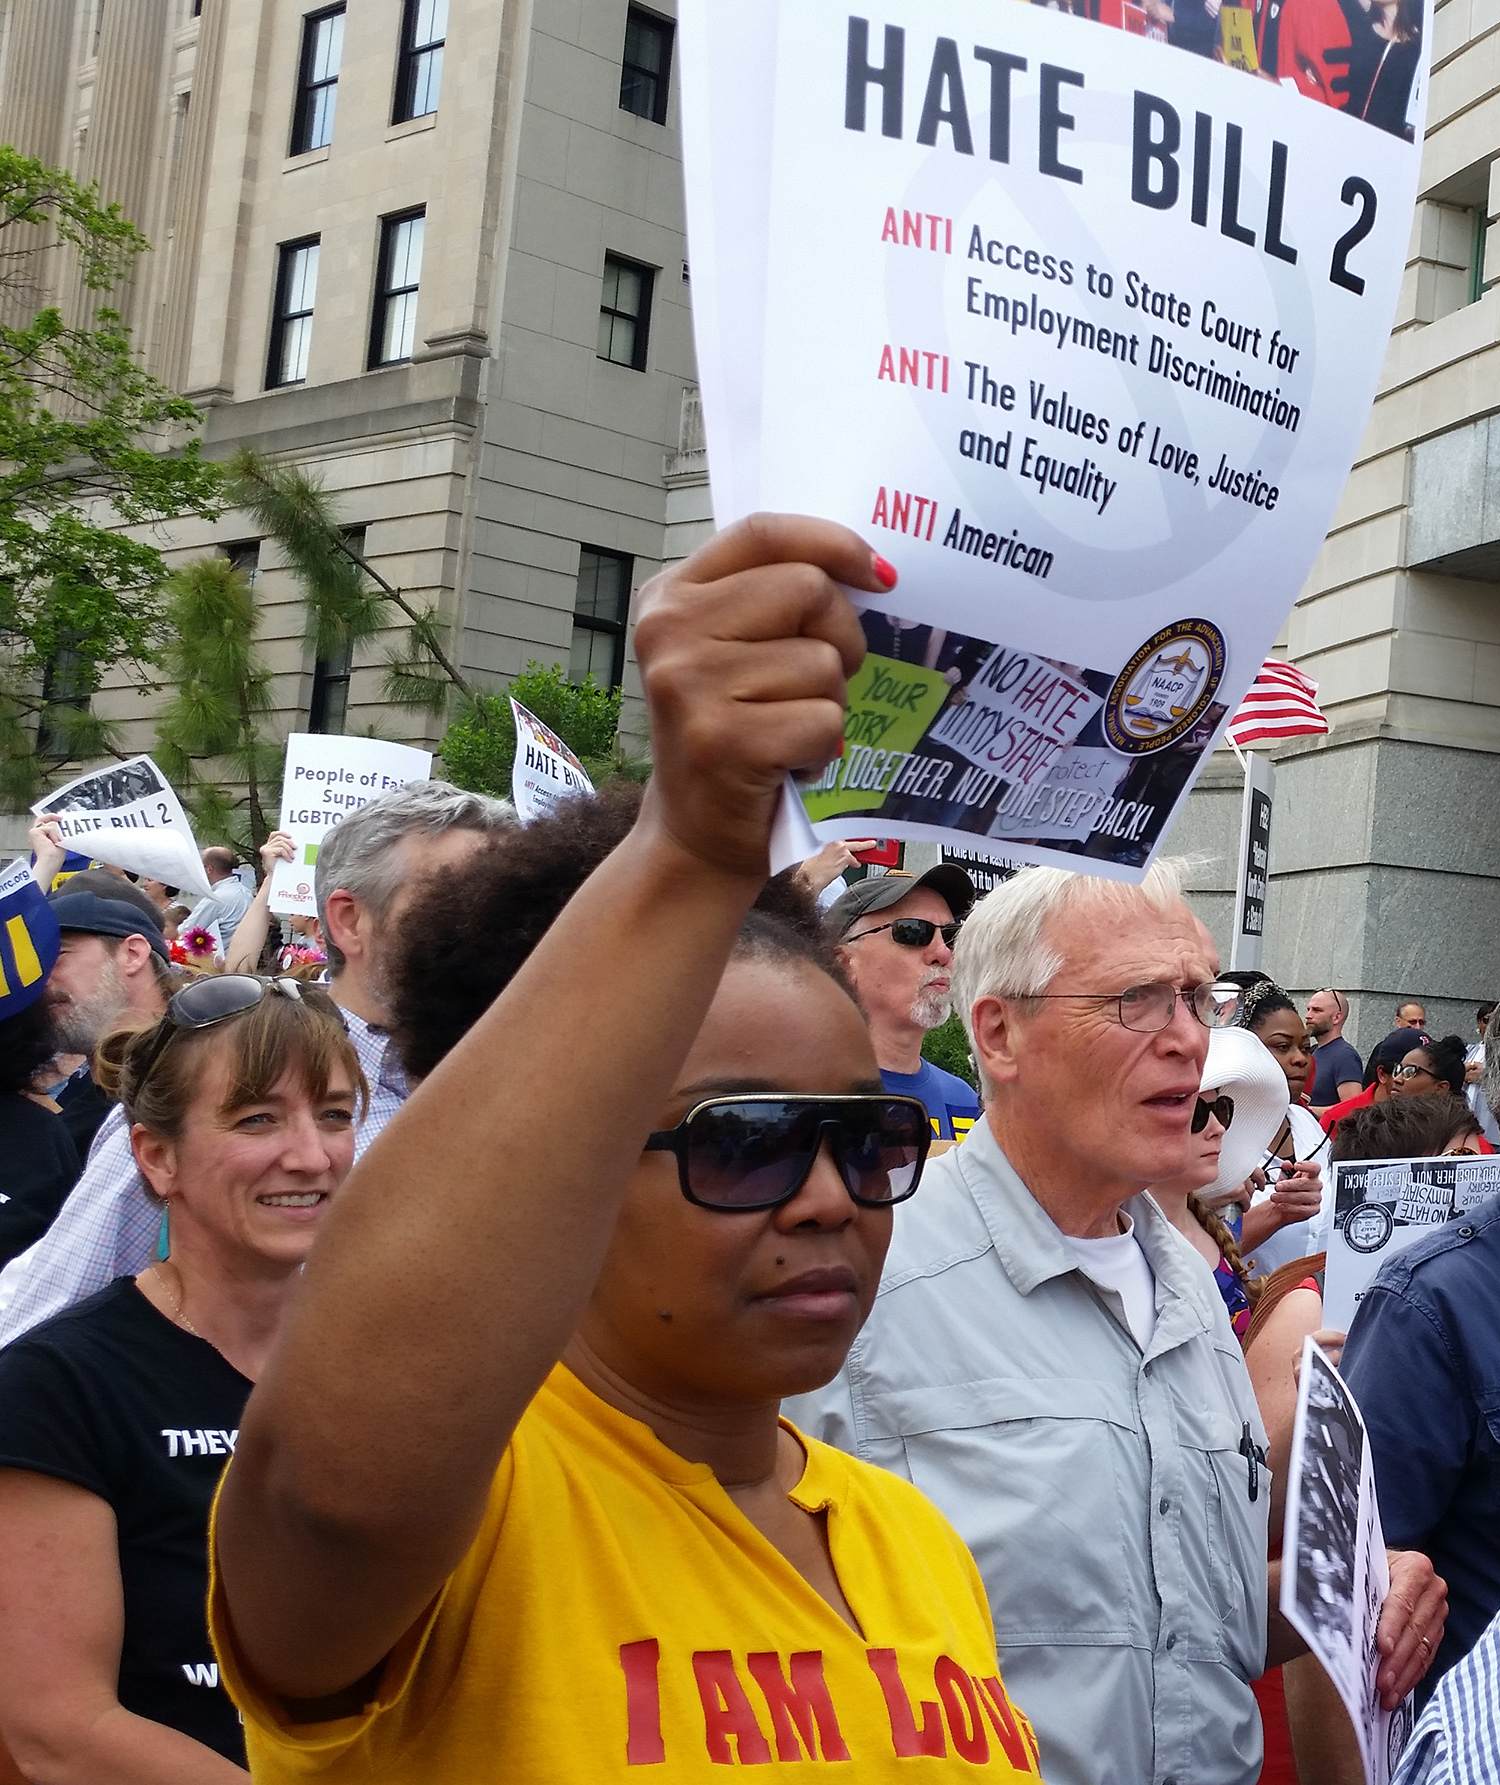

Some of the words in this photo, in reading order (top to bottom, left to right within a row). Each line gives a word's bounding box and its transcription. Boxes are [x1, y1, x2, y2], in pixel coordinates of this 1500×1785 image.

[845, 15, 1085, 185] HATE
[1131, 89, 1298, 265] BILL
[1329, 176, 1378, 296] 2
[881, 206, 953, 255] ANTI
[967, 224, 1074, 286] Access
[1087, 264, 1114, 299] to
[1125, 271, 1191, 328] State
[1201, 300, 1262, 359] Court
[1268, 330, 1300, 374] for
[967, 276, 1139, 366] Employment
[1148, 334, 1301, 432] Discrimination
[877, 344, 949, 394] ANTI
[964, 360, 1016, 411] The
[1030, 380, 1110, 445] Values
[1118, 421, 1146, 458] of
[1148, 426, 1200, 487] Love,
[1208, 454, 1279, 511] Justice
[959, 429, 1012, 470] and
[1020, 436, 1117, 516] Equality
[871, 486, 939, 542] ANTI
[943, 508, 1054, 578] American
[1154, 629, 1172, 644] FOR
[1177, 622, 1193, 633] THE
[1195, 623, 1223, 671] ADVANCEMENT
[862, 666, 928, 712] YOUR
[1110, 644, 1151, 705] ASSOCIATION
[1152, 677, 1184, 693] NAACP
[1210, 677, 1218, 689] OF
[980, 649, 1029, 693] NO
[1012, 666, 1090, 736] HATE
[1151, 698, 1166, 708] 1909
[846, 705, 898, 746] OTRY
[1107, 712, 1127, 747] NATIONAL
[1176, 694, 1211, 735] COLORED
[1138, 735, 1172, 750] PEOPLE
[295, 767, 355, 785] People
[360, 773, 378, 788] of
[525, 744, 559, 780] HATE
[842, 744, 943, 799] TOGETHER.
[950, 761, 1000, 809] NOT
[996, 781, 1051, 820] ONE
[1040, 787, 1098, 828] STEP
[1092, 795, 1155, 842] BACK!
[58, 818, 102, 837] HATE
[111, 810, 155, 828] BILL
[157, 803, 172, 824] 2
[984, 870, 992, 891] to
[1344, 1174, 1369, 1190] BACK!
[1373, 1172, 1395, 1186] STEP
[1416, 1170, 1432, 1184] NOT
[1399, 1203, 1430, 1221] HATE
[1432, 1209, 1447, 1223] NO
[160, 1429, 239, 1457] THEY
[619, 1638, 665, 1764] I
[692, 1649, 852, 1765] AM
